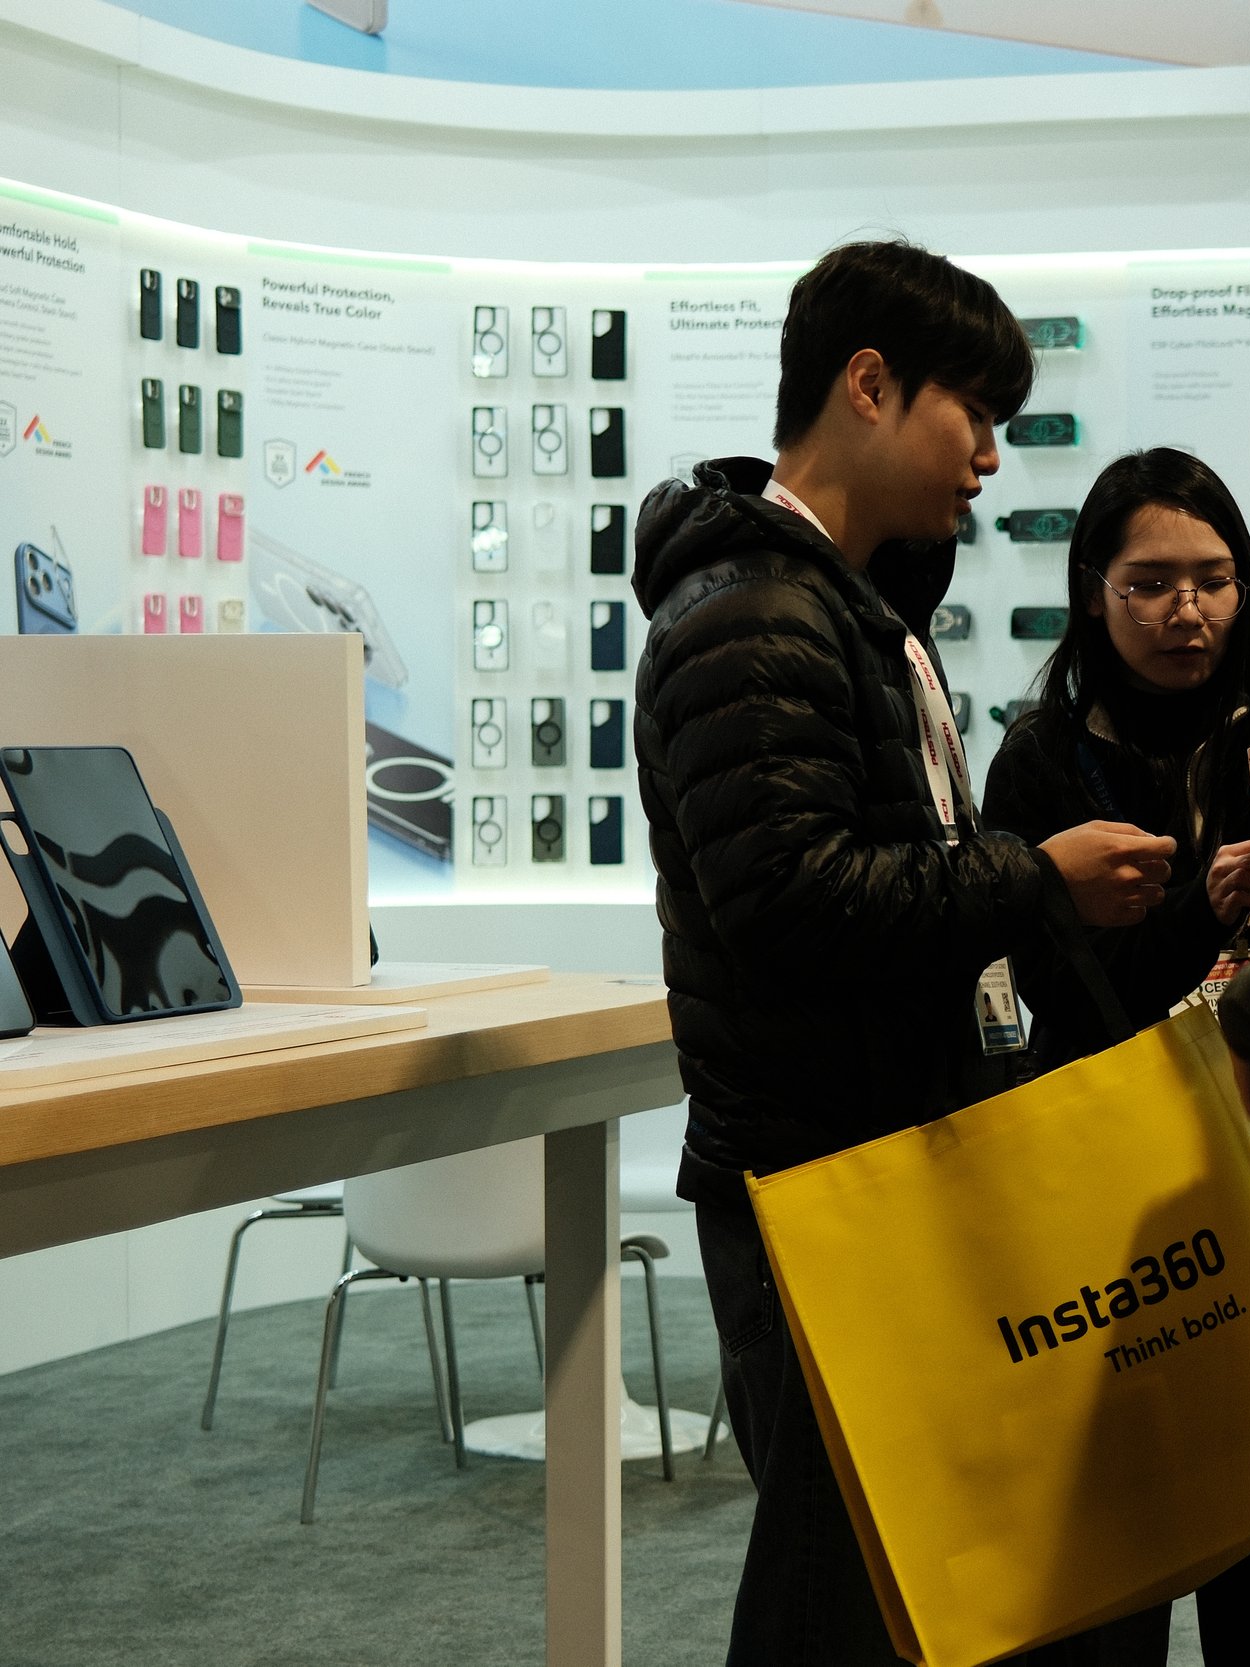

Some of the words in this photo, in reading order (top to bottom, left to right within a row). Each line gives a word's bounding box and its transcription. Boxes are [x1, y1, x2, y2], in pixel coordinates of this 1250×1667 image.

[0, 246, 34, 262] werful
[36, 250, 86, 274] Protection
[262, 277, 319, 296] Powerful
[322, 285, 396, 304] Protection,
[1152, 285, 1233, 303] Drop-proof
[262, 296, 311, 314] Reveals
[313, 302, 342, 317] True
[345, 304, 383, 320] Color
[670, 300, 736, 313] Effortless
[1152, 304, 1219, 318] Effortless
[670, 318, 730, 331] Ultimate
[734, 318, 784, 331] Protect
[996, 1228, 1226, 1364] Insta360
[1104, 1326, 1180, 1373] Think
[1181, 1293, 1247, 1340] bold.
